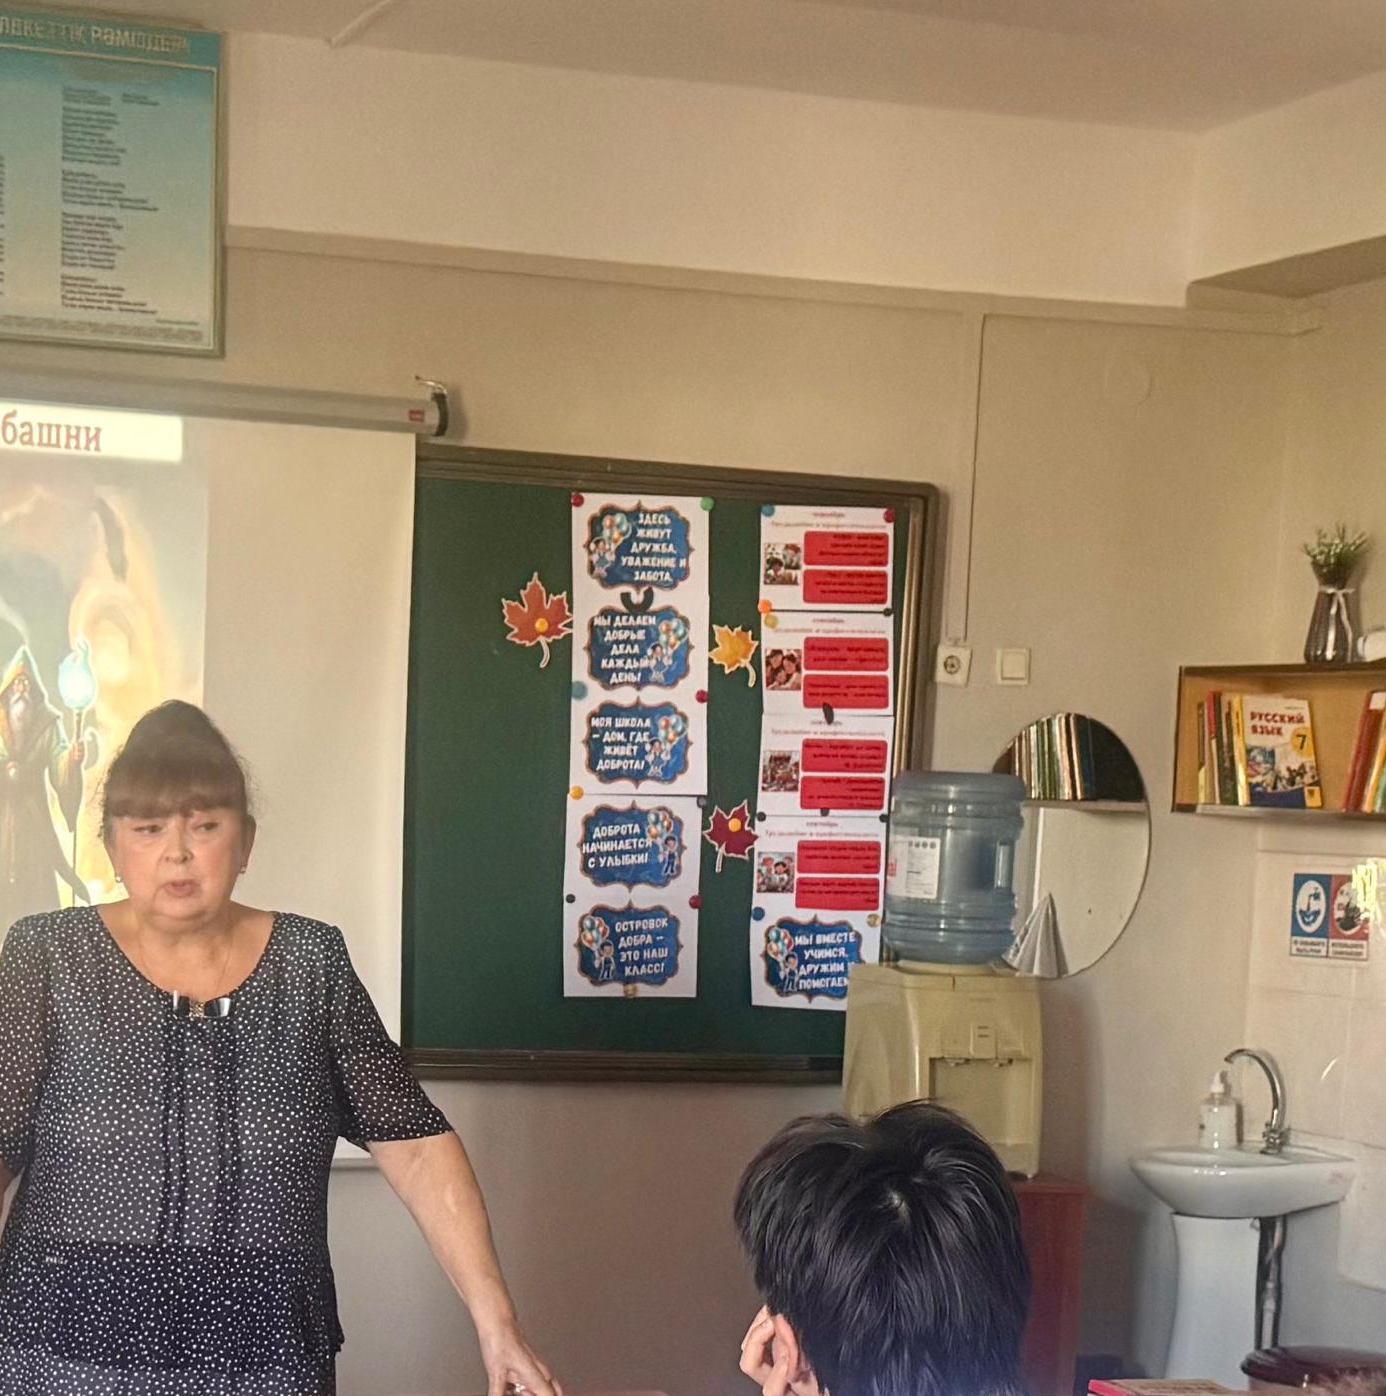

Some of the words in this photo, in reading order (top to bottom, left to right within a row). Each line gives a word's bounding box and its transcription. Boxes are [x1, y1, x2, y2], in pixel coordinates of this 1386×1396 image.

[1, 409, 103, 452] башни
[638, 512, 671, 526] ЗДЕСЬ
[637, 527, 672, 540] ЖИВУТ
[621, 556, 677, 569] УВАЖЕНИЕ
[679, 558, 686, 569] И
[594, 615, 611, 626] МЫ
[613, 616, 657, 628] ДЕЛАЕМ
[604, 629, 646, 642] ДОБРЫЕ
[610, 643, 640, 656] ДЕЛА
[609, 671, 641, 684] ДЕНЬ!
[591, 717, 612, 728] МОЯ
[615, 716, 651, 728] ШКОЛА
[1250, 711, 1305, 723] РУССКИЙ
[1251, 725, 1284, 736] ЯЗЫК
[1296, 734, 1307, 750] 7
[596, 758, 645, 772] ДОБРОТА!
[593, 824, 640, 839] ДОБРОТА
[582, 839, 653, 854] НАЧИНАЕТСЯ
[588, 857, 596, 868] С
[598, 853, 648, 868] УЛЫБКИ!
[615, 917, 668, 932] ОСТРОВОК
[618, 934, 652, 948] ДОБРА
[795, 935, 813, 946] МЫ
[815, 932, 856, 945] ВМЕСТЕ
[620, 949, 640, 962] ЭТО
[643, 947, 668, 960] НАШ
[625, 964, 665, 977] КЛАСС!
[799, 962, 845, 976] ДРУЖИМ
